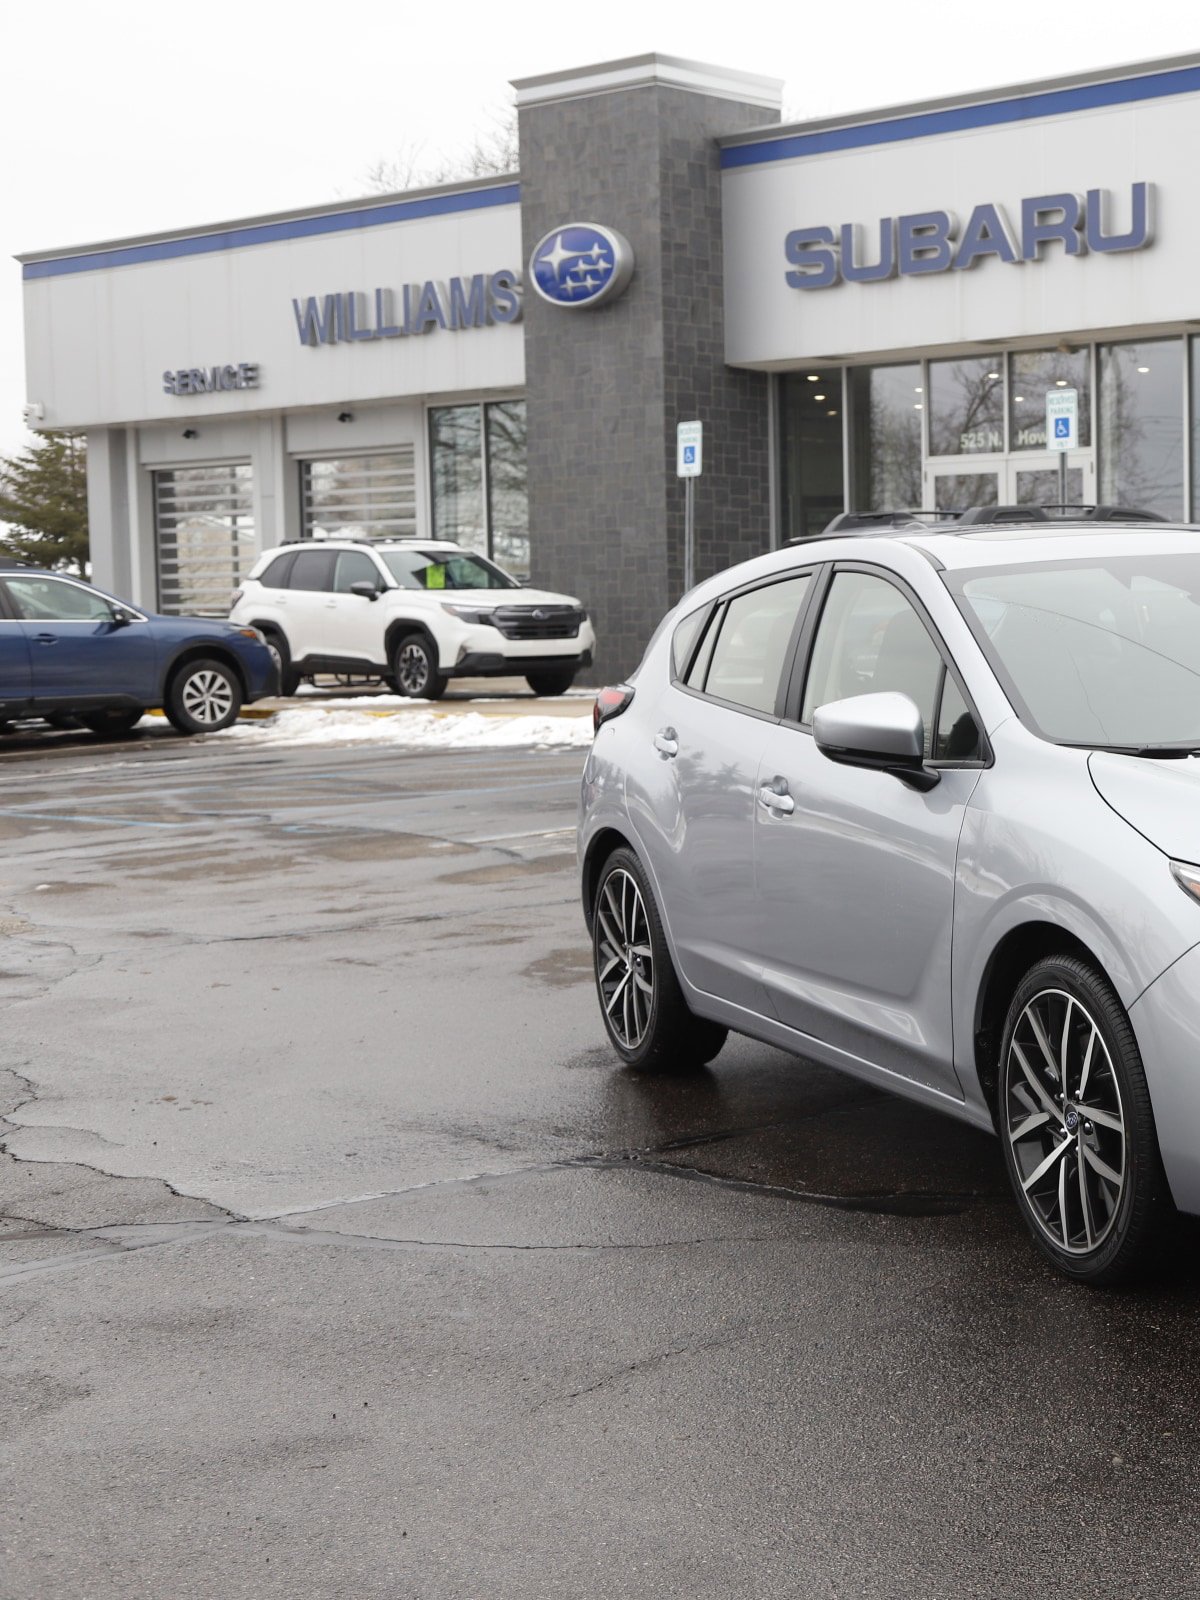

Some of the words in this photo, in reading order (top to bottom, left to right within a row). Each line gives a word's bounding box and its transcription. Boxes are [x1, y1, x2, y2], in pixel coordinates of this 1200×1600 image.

[784, 181, 1151, 290] SUBARU
[292, 269, 522, 347] WILLIAMS
[162, 363, 260, 396] SERVICE
[960, 432, 986, 449] 525
[1017, 428, 1047, 445] How
